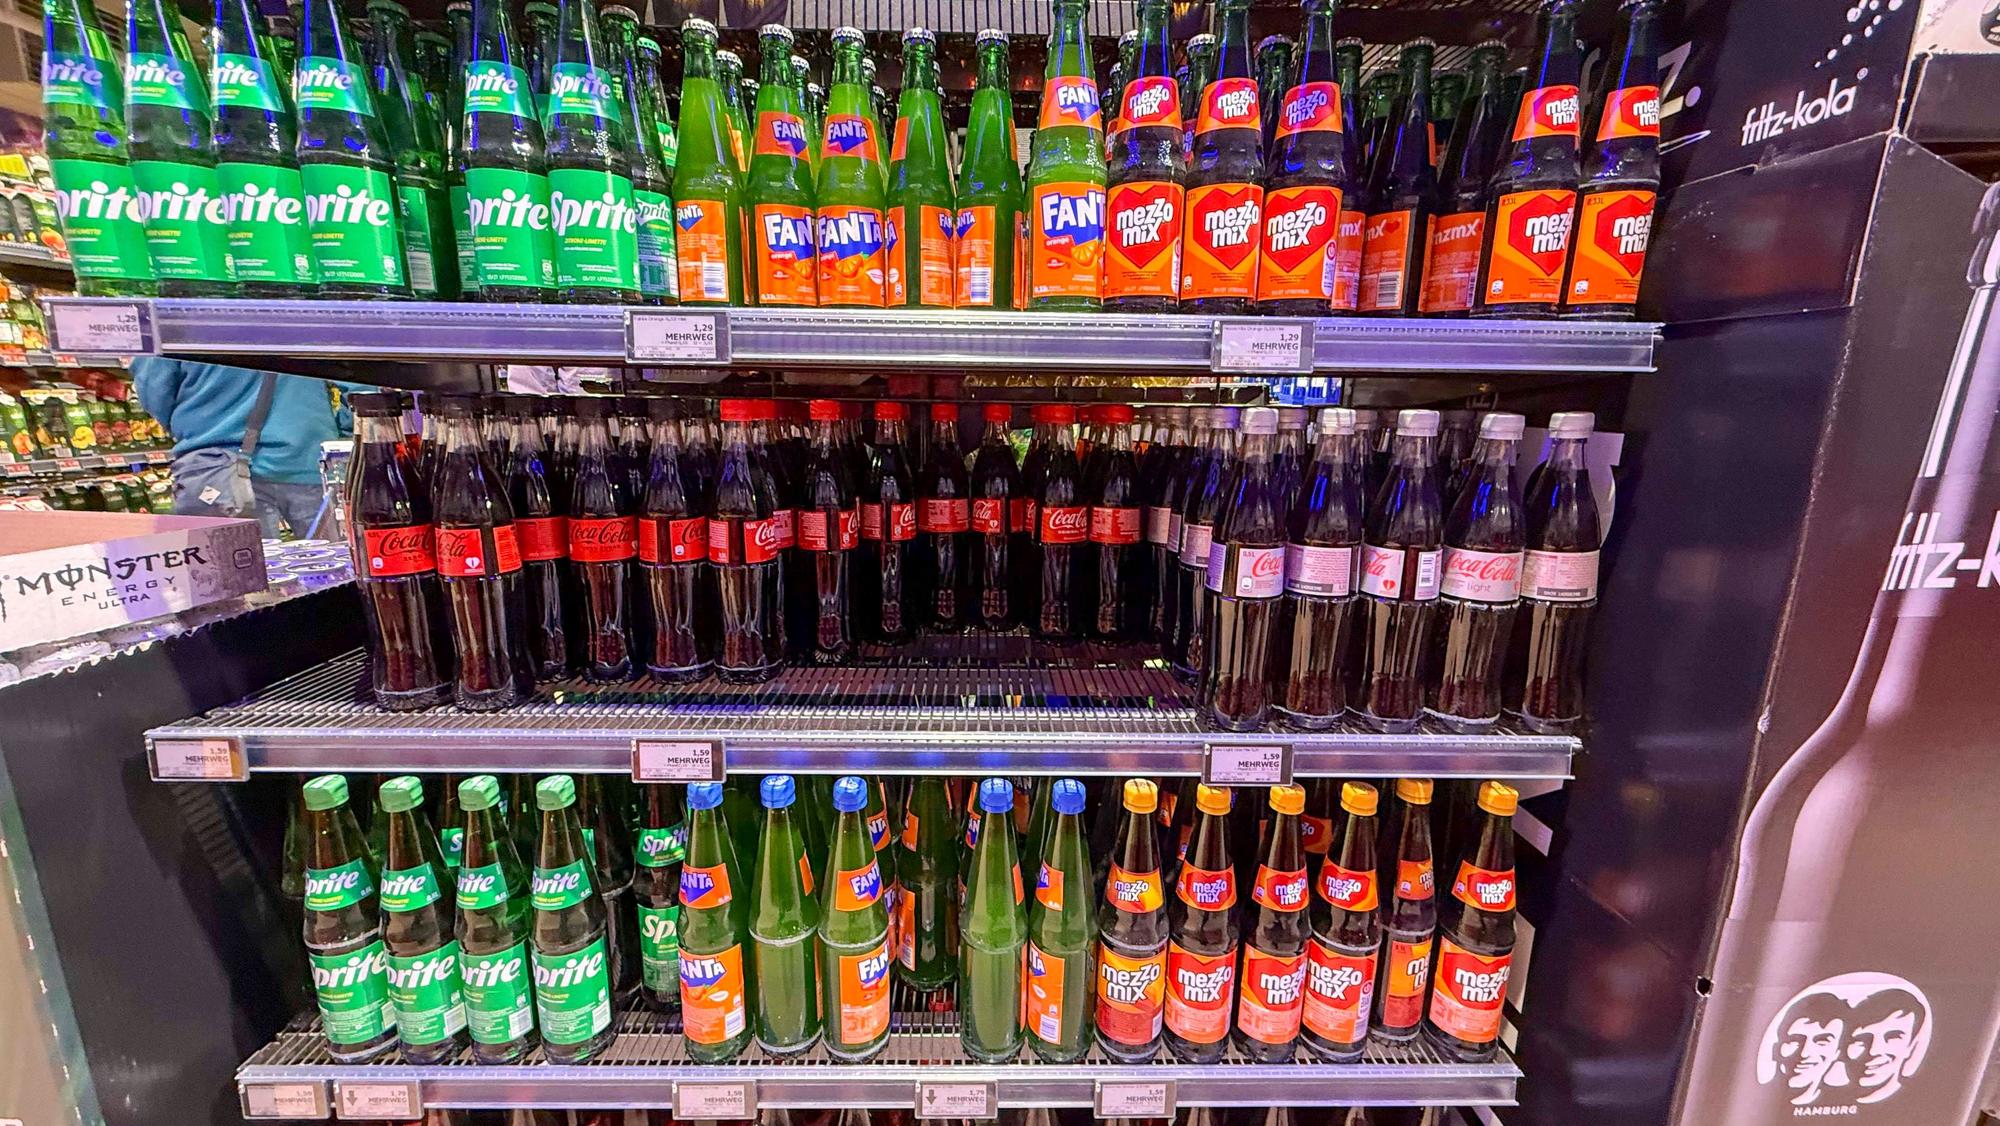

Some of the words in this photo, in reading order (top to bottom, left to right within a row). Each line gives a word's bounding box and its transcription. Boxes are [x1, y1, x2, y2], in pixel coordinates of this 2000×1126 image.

[44, 59, 103, 85] prite
[127, 60, 186, 86] prite
[216, 61, 259, 86] rite
[299, 64, 354, 90] prite
[551, 72, 611, 99] Sprite
[1058, 85, 1100, 106] FANT
[1133, 102, 1160, 120] mix
[1223, 103, 1251, 120] mix
[1288, 105, 1317, 122] mix
[1741, 78, 1857, 146] fritz-kola
[827, 119, 869, 143] FANTA
[138, 181, 225, 225] prite
[306, 184, 391, 227] prite
[467, 189, 549, 235] prite
[551, 190, 637, 236] Sprite
[1042, 191, 1106, 231] FANT
[1116, 197, 1174, 228] mezzo
[1204, 199, 1260, 230] mezzo
[1267, 201, 1327, 235] mezzo
[764, 212, 814, 247] FAN
[818, 212, 883, 248] FANTA
[1121, 220, 1163, 248] mix
[1211, 222, 1254, 248] mix
[1271, 225, 1314, 252] mix
[88, 324, 139, 333] MEHRWEG
[665, 333, 714, 341] MEHRWEG
[693, 324, 713, 332] 1,29
[1280, 333, 1299, 341] 1,29
[1251, 342, 1299, 350] MEHRWEG
[1880, 510, 2000, 592] fritz-k
[61, 575, 176, 607] ENERGY
[1466, 580, 1492, 594] light
[99, 592, 151, 610] ULTRA
[667, 757, 711, 765] MEHRWEG
[692, 749, 710, 757] 1,59
[1263, 753, 1280, 761] 1,59
[1238, 761, 1280, 769] MEHRWEG
[381, 874, 427, 896] prite
[851, 864, 880, 894] FANT
[1118, 889, 1141, 902] mix
[1195, 889, 1222, 903] mix
[1280, 892, 1302, 905] mix
[1327, 887, 1352, 901] mix
[1481, 890, 1506, 903] mix
[386, 955, 456, 988] prite
[857, 942, 889, 982] FAN
[1101, 963, 1161, 985] mezzo
[1177, 965, 1233, 985] mezzo
[1106, 980, 1150, 1002] mix
[1183, 981, 1222, 1003] mix
[1310, 975, 1351, 1000] mix
[1461, 981, 1503, 1002] mix
[1793, 1104, 1858, 1117] HAMBURG
